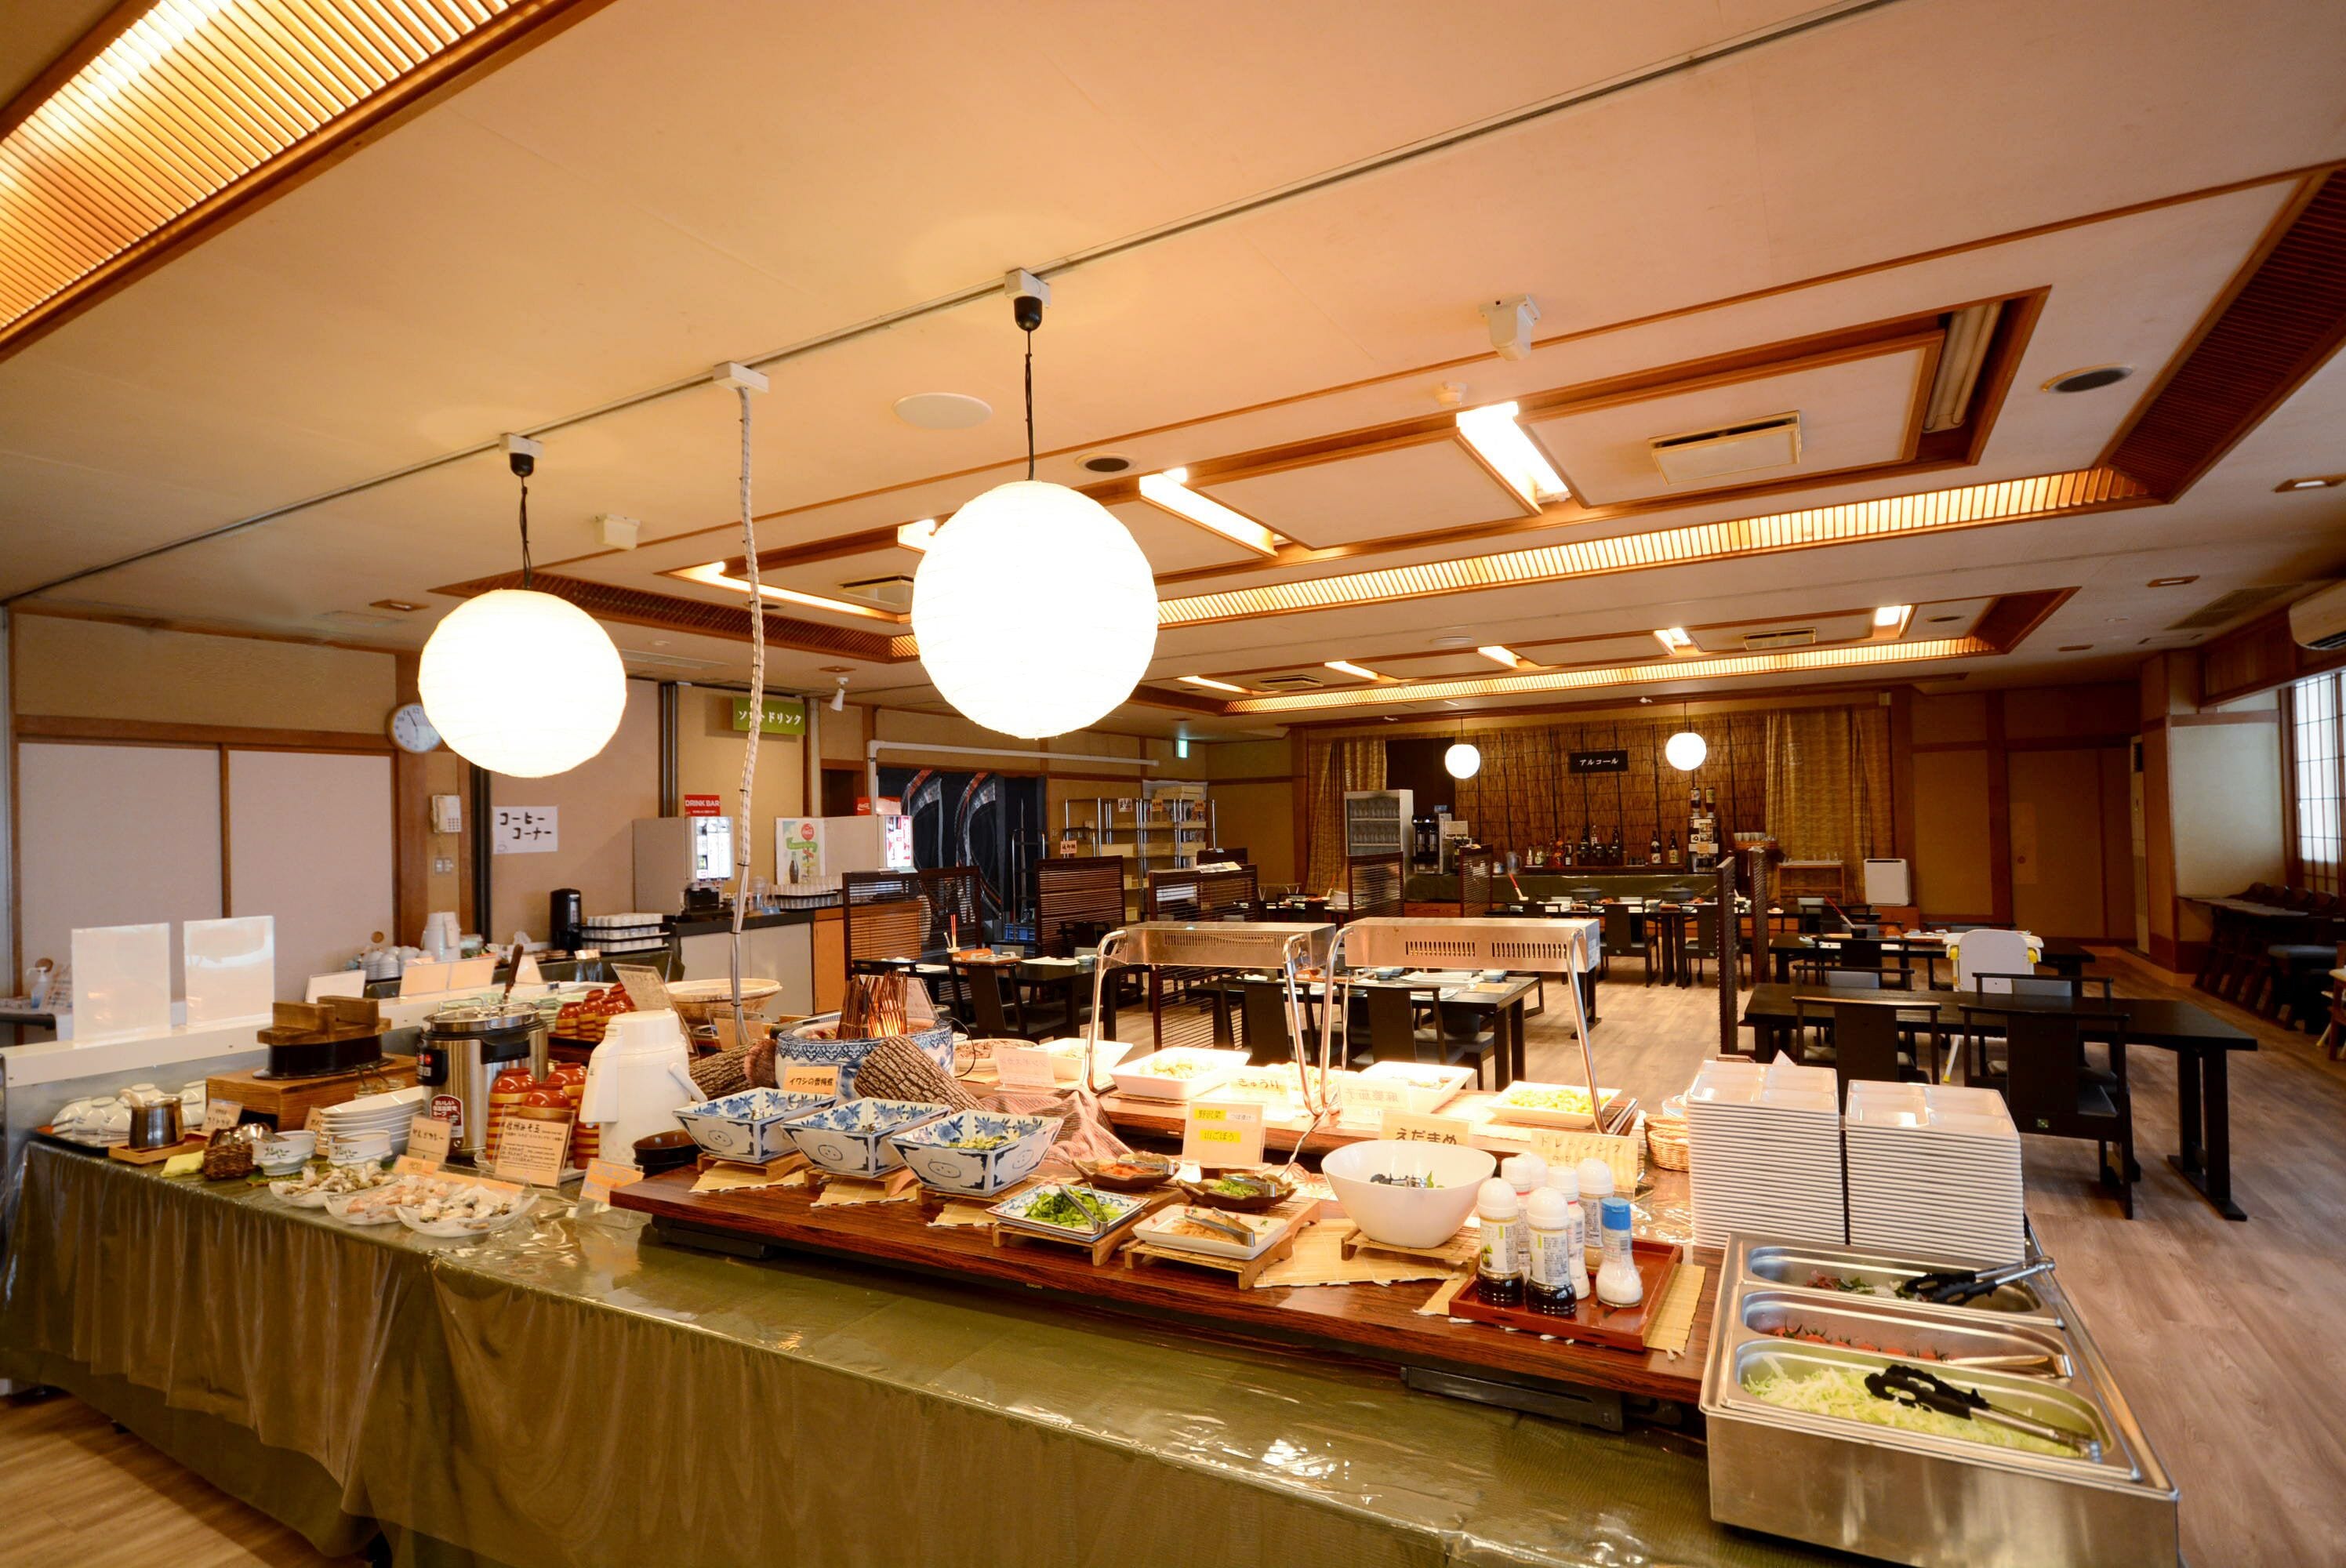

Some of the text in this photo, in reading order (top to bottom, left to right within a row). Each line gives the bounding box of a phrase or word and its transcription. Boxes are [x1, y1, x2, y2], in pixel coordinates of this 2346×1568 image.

[1579, 757, 1619, 767] アルコール
[685, 799, 706, 808] DRINK
[499, 811, 546, 826] コーヒー
[512, 826, 552, 840] コーナー
[1198, 1109, 1222, 1120] 野沢菜
[1204, 1131, 1235, 1142] 山ごぼう
[1395, 1127, 1458, 1145] えだまめ
